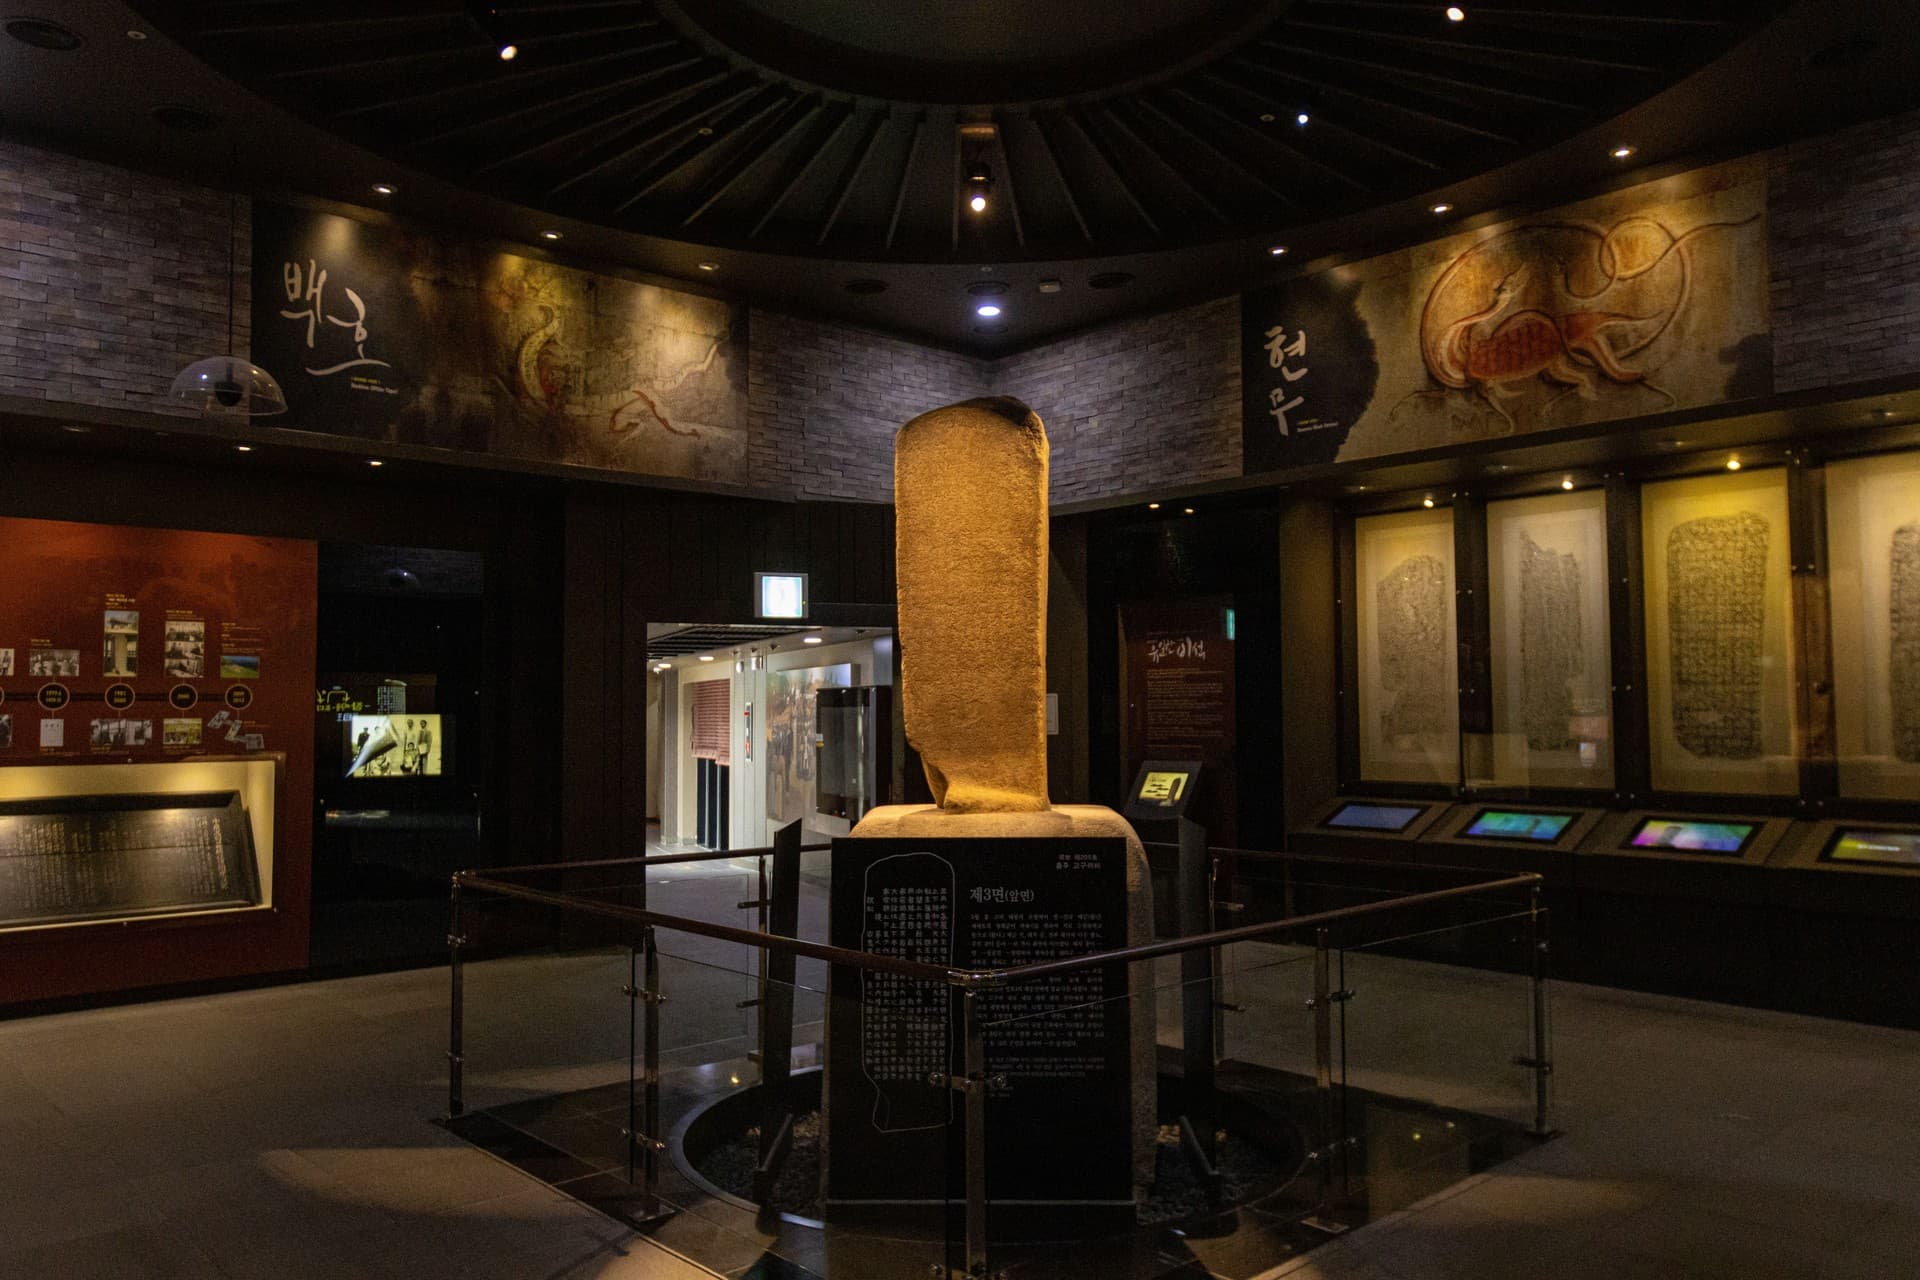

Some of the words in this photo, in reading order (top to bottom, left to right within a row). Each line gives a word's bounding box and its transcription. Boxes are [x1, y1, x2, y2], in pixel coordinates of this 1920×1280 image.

[279, 258, 391, 376] 백호
[1263, 324, 1309, 437] 현무
[969, 886, 1035, 903] 제3면(앞면)
